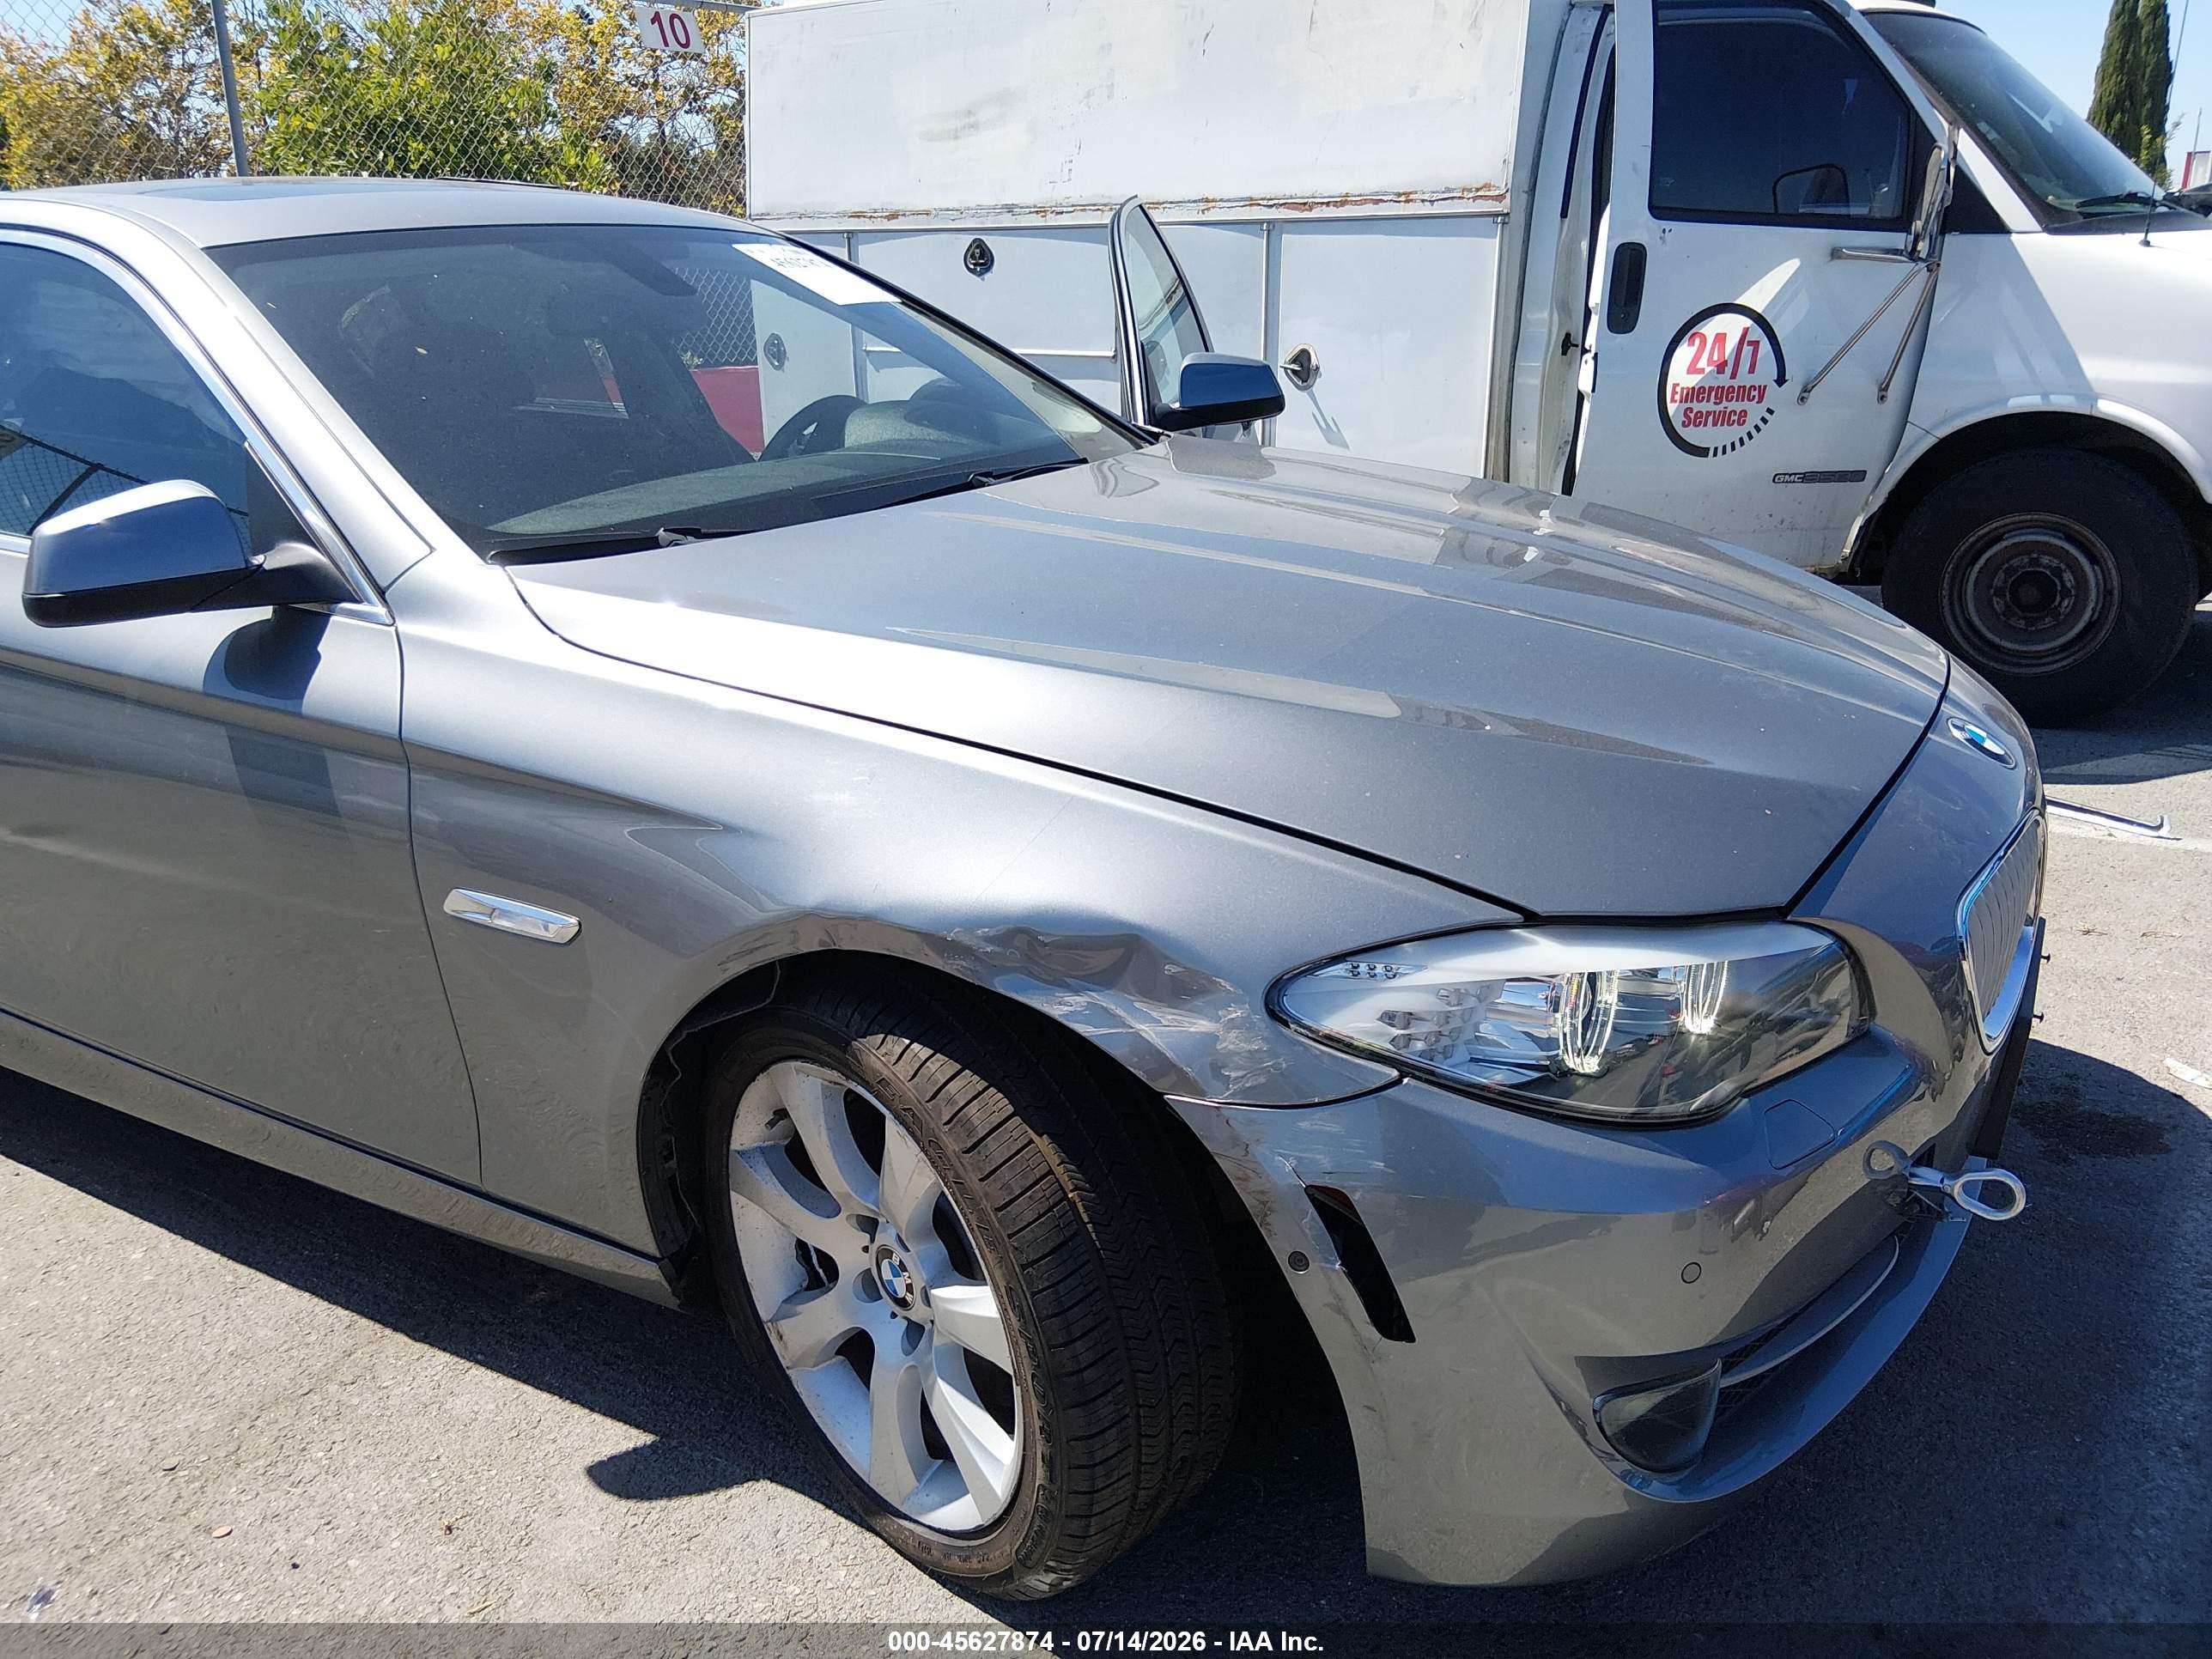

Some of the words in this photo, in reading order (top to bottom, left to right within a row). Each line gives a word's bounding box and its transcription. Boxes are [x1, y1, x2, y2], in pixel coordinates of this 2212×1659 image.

[650, 10, 691, 50] 10
[1686, 326, 1760, 380] 24/7
[1669, 383, 1767, 405] Emergency
[1681, 406, 1748, 428] Service
[1774, 473, 1804, 483] GMC
